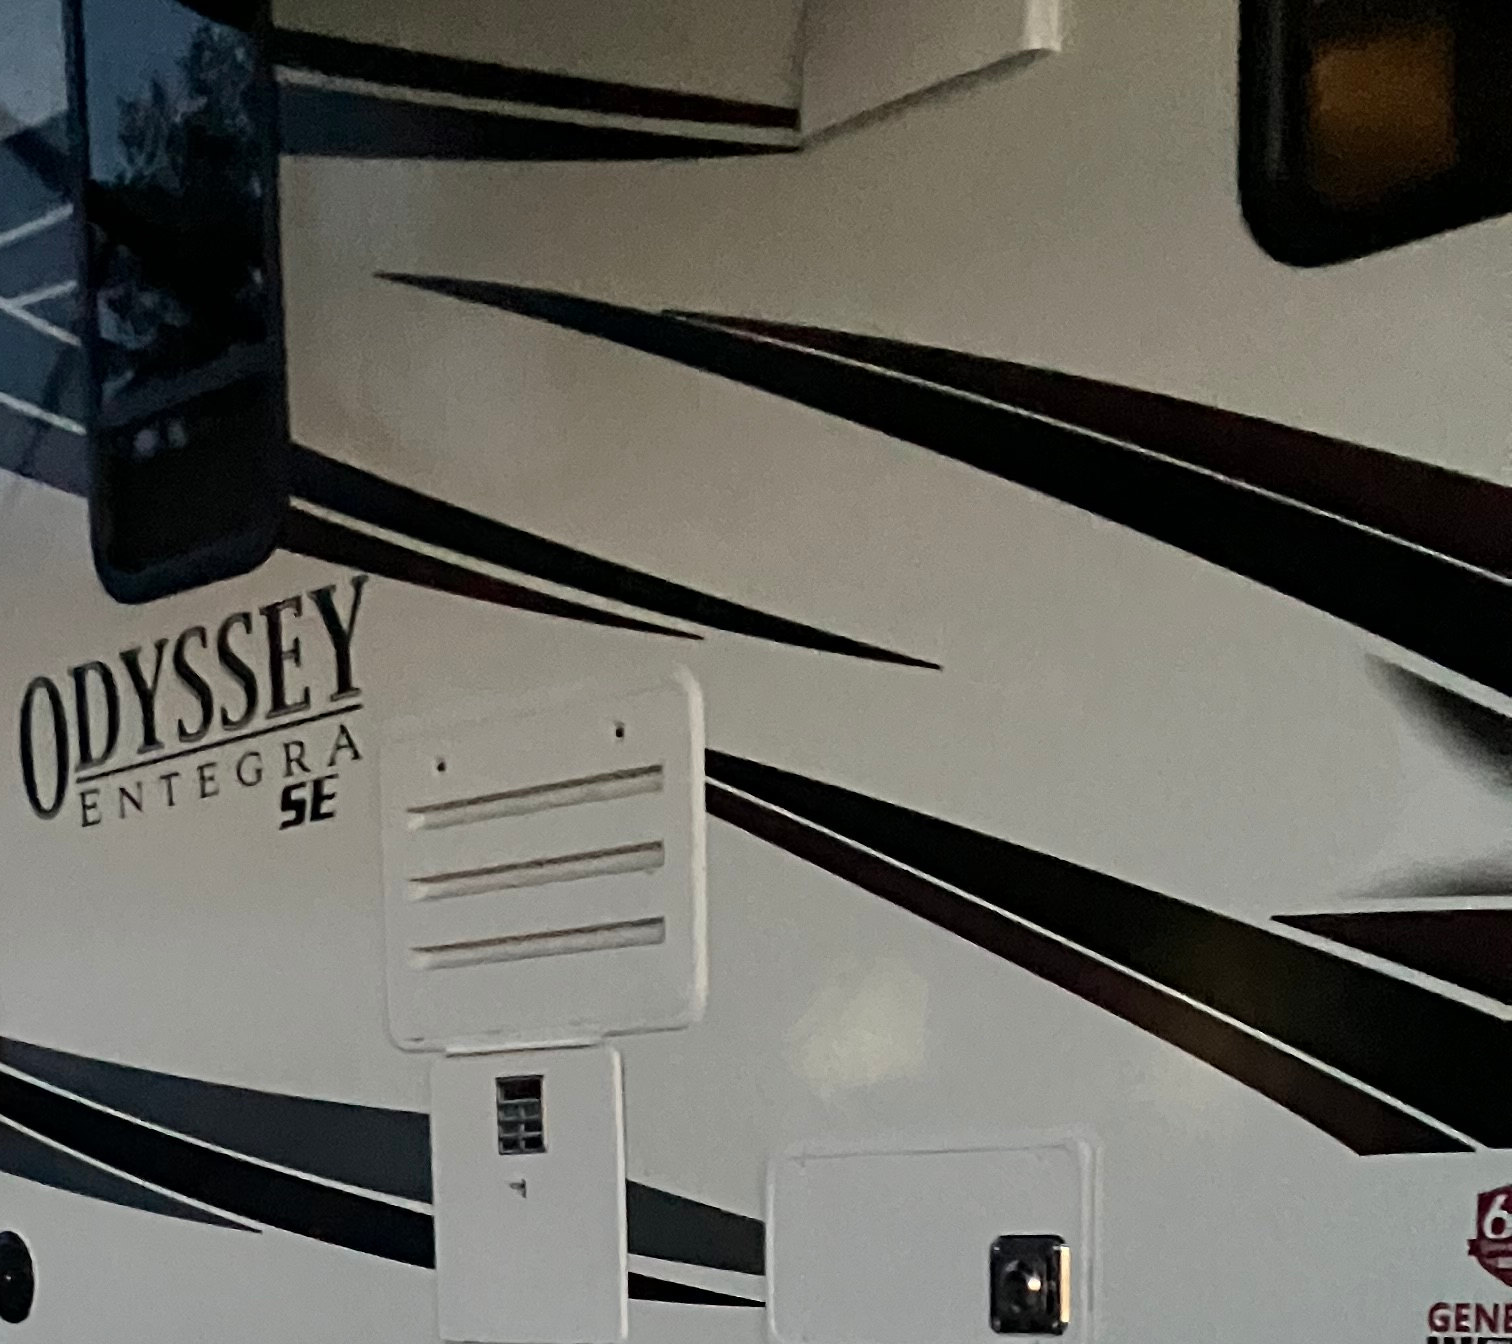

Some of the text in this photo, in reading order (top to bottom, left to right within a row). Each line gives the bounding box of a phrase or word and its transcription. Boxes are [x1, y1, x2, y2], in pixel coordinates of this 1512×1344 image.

[20, 575, 369, 820] ODYSSEY
[78, 724, 363, 827] ENTEGRA
[279, 773, 339, 830] SE
